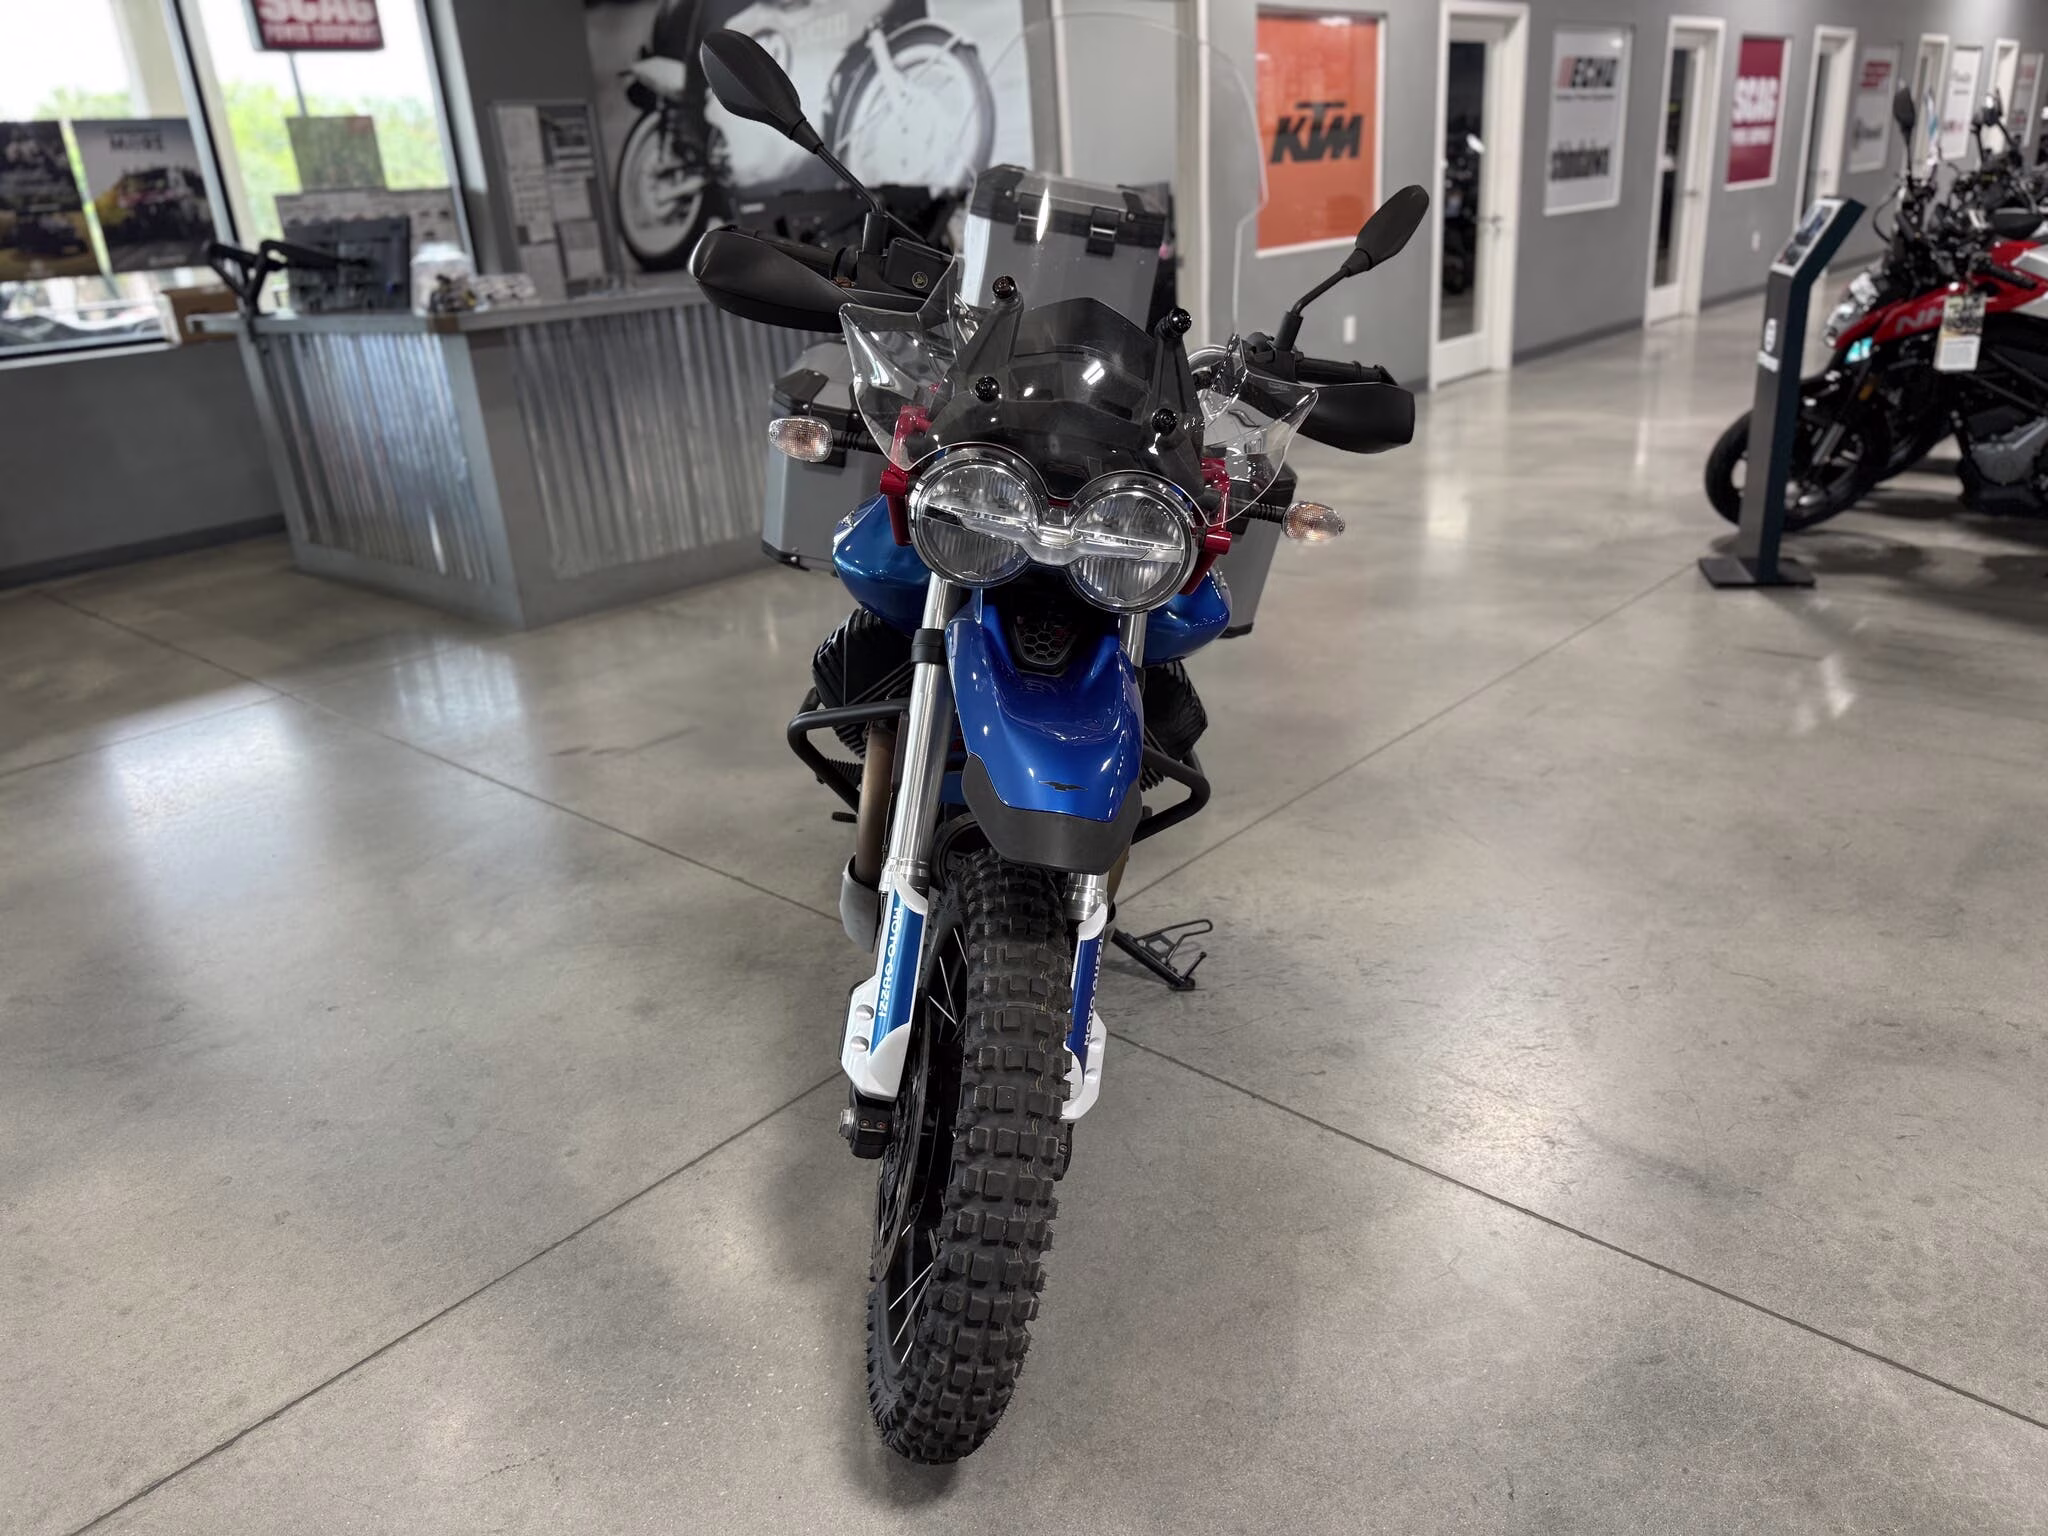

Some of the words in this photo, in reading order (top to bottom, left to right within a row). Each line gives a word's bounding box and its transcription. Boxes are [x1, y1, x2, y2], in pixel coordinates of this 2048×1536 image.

[1570, 56, 1618, 89] ECHO
[1733, 77, 1777, 121] SCAG
[1270, 101, 1363, 163] KTM
[887, 907, 903, 957] MOTO
[878, 963, 894, 1017] GUZZI
[1084, 996, 1095, 1046] MOTO
